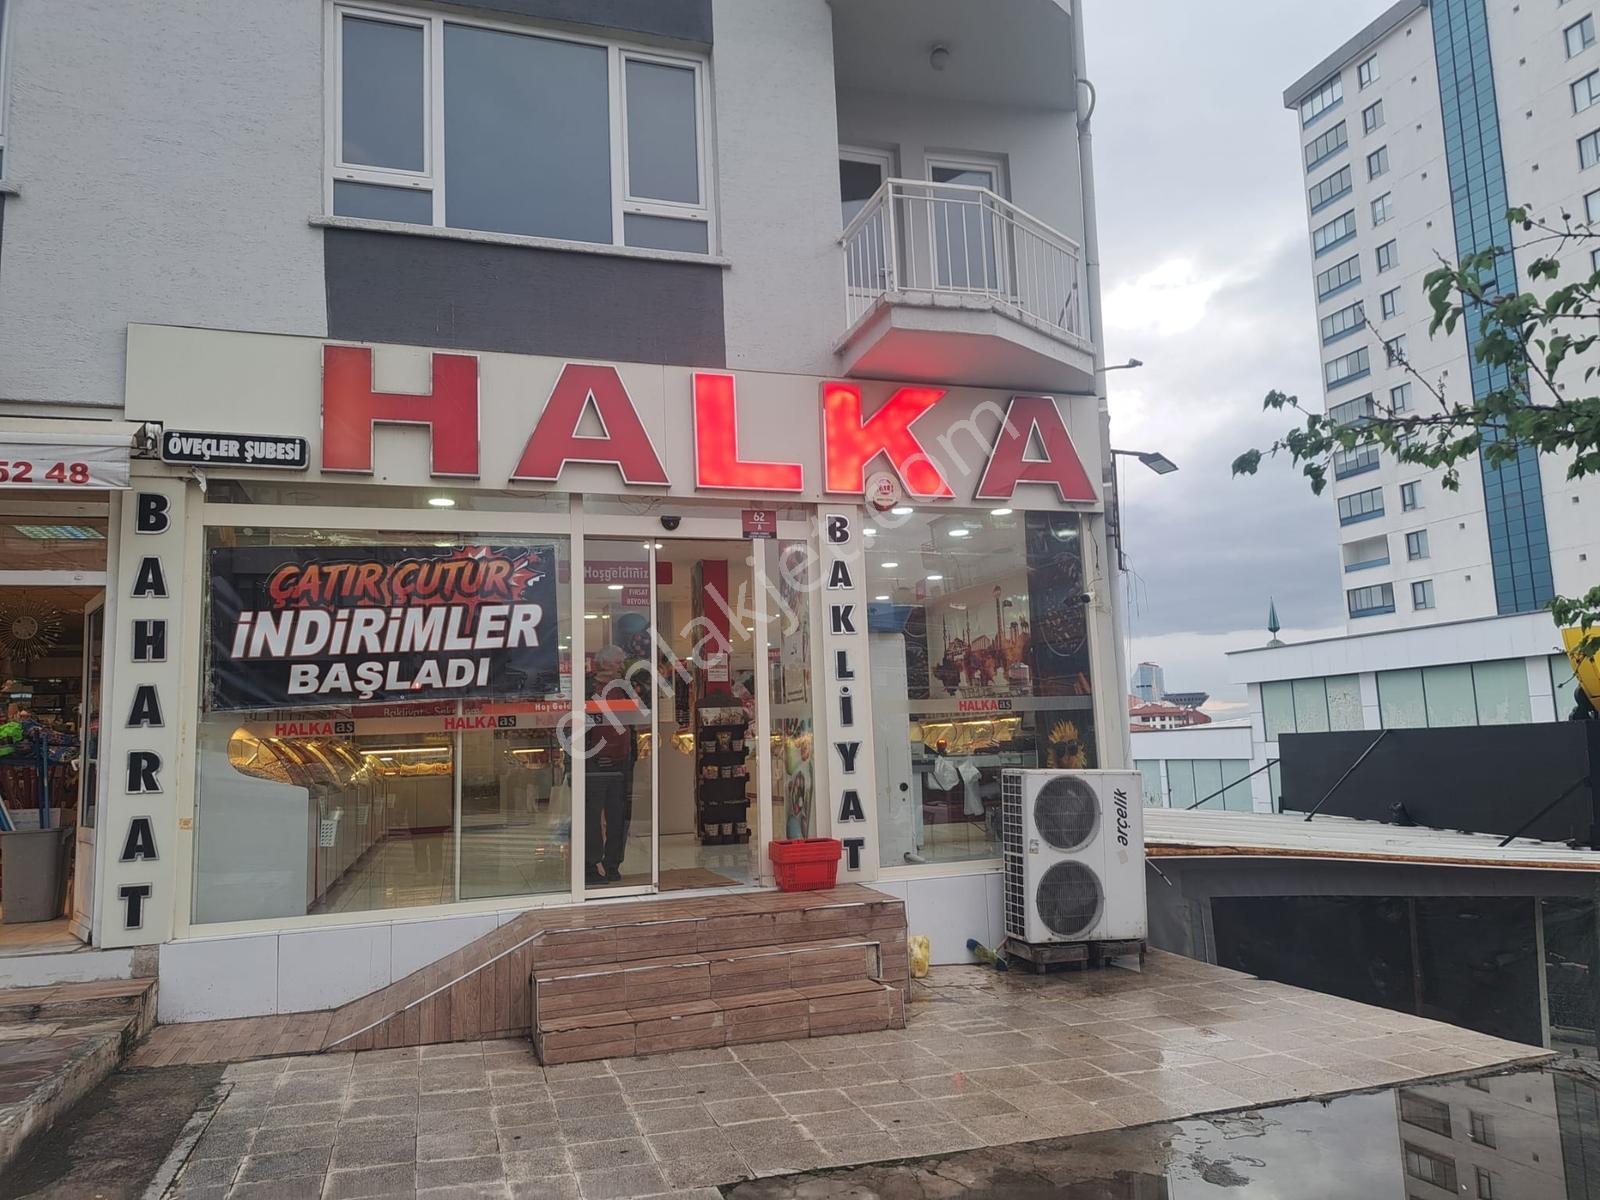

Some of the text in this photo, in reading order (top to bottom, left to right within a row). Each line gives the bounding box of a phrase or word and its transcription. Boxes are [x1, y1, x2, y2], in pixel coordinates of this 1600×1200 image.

[321, 343, 1098, 503] HALKA
[168, 433, 301, 463] ÖVEÇLER ŞUBESİ
[45, 462, 90, 484] 48
[753, 511, 765, 521] 62
[269, 559, 511, 606] ÇATIR ÇUTUR
[287, 657, 491, 699] BAŞLADI
[825, 513, 866, 871] BAKLİYAT
[118, 492, 171, 930] BAHARAT
[444, 716, 496, 730] HALKA
[959, 700, 997, 712] HALKA
[274, 722, 333, 736] HALKA
[1113, 788, 1131, 847] arçelik
